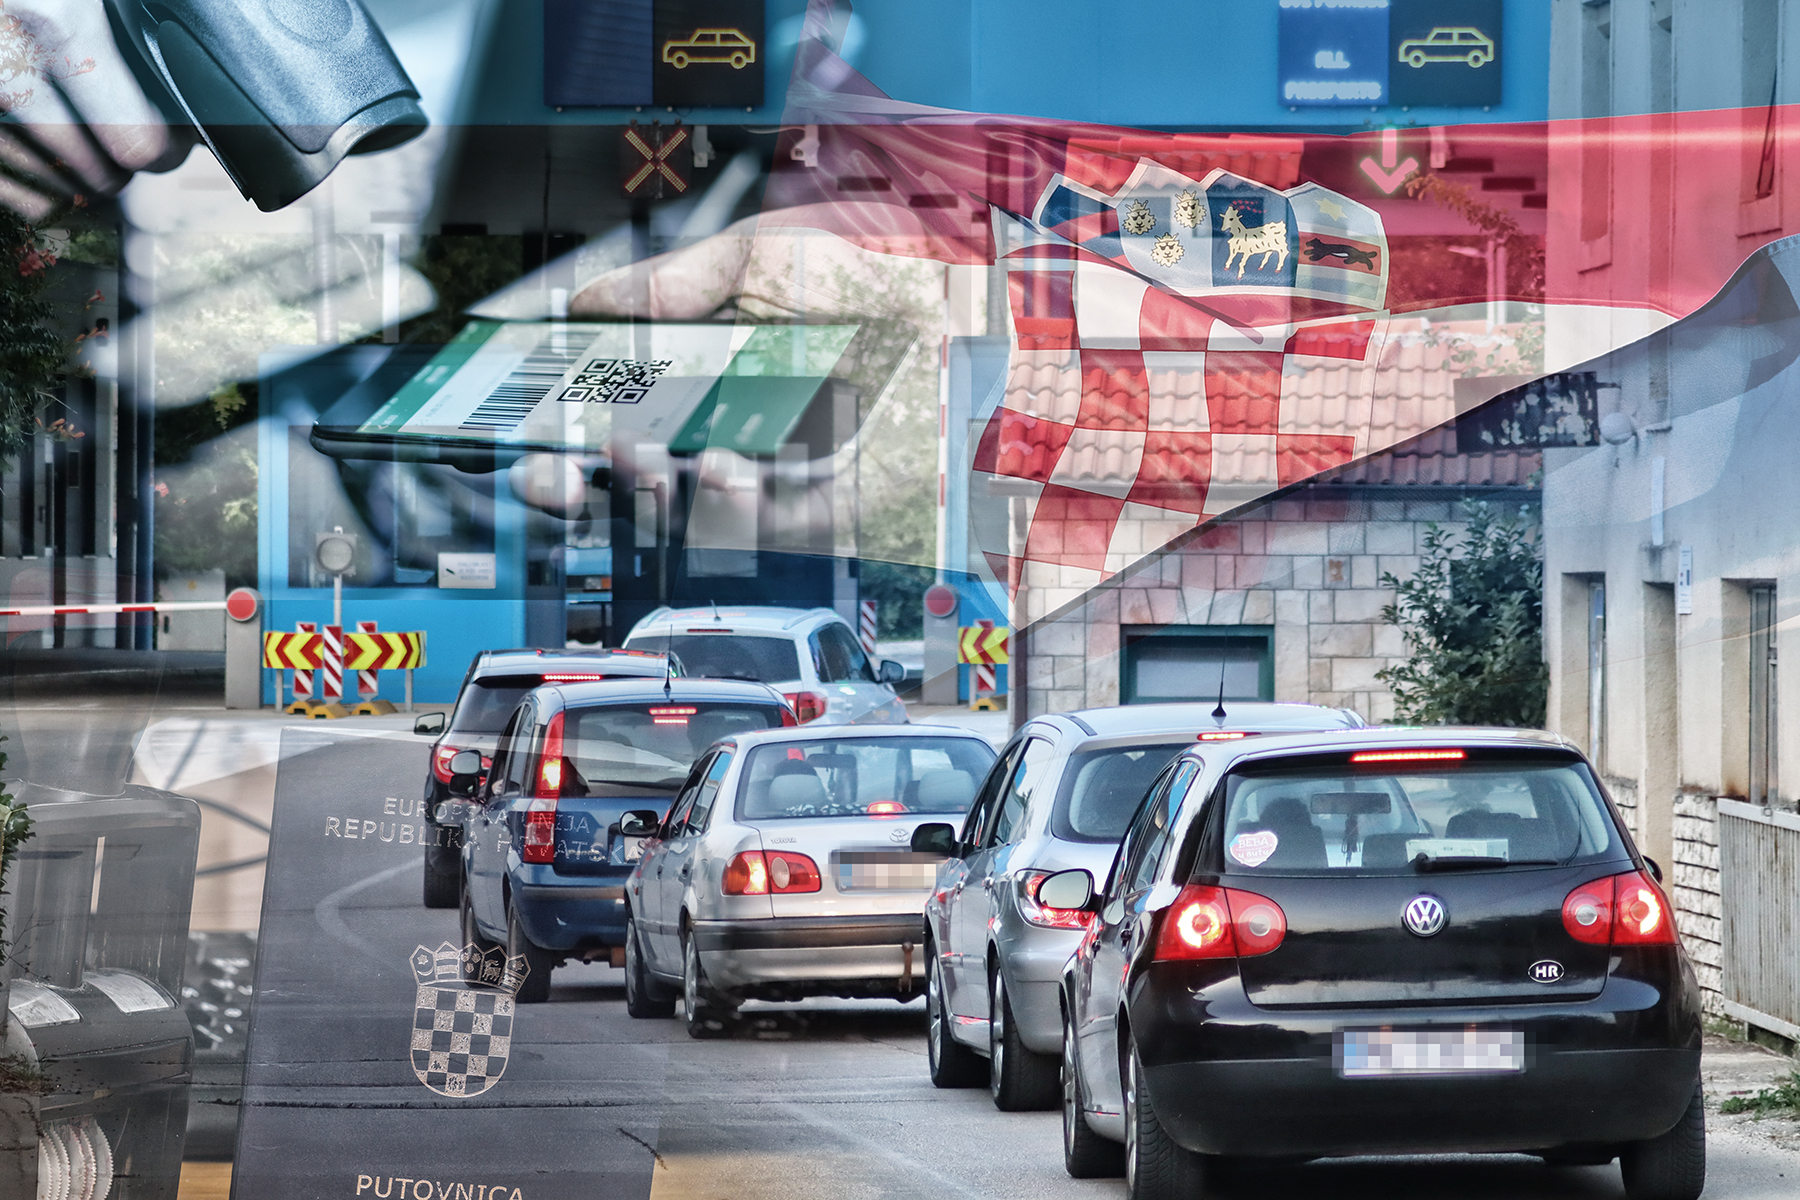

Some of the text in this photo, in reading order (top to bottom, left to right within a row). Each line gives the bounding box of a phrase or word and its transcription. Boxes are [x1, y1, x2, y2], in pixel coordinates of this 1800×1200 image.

[325, 816, 481, 850] REPUBLIKA
[770, 837, 797, 845] TOYOTA
[1238, 837, 1269, 849] BEBA
[1535, 966, 1559, 978] HR
